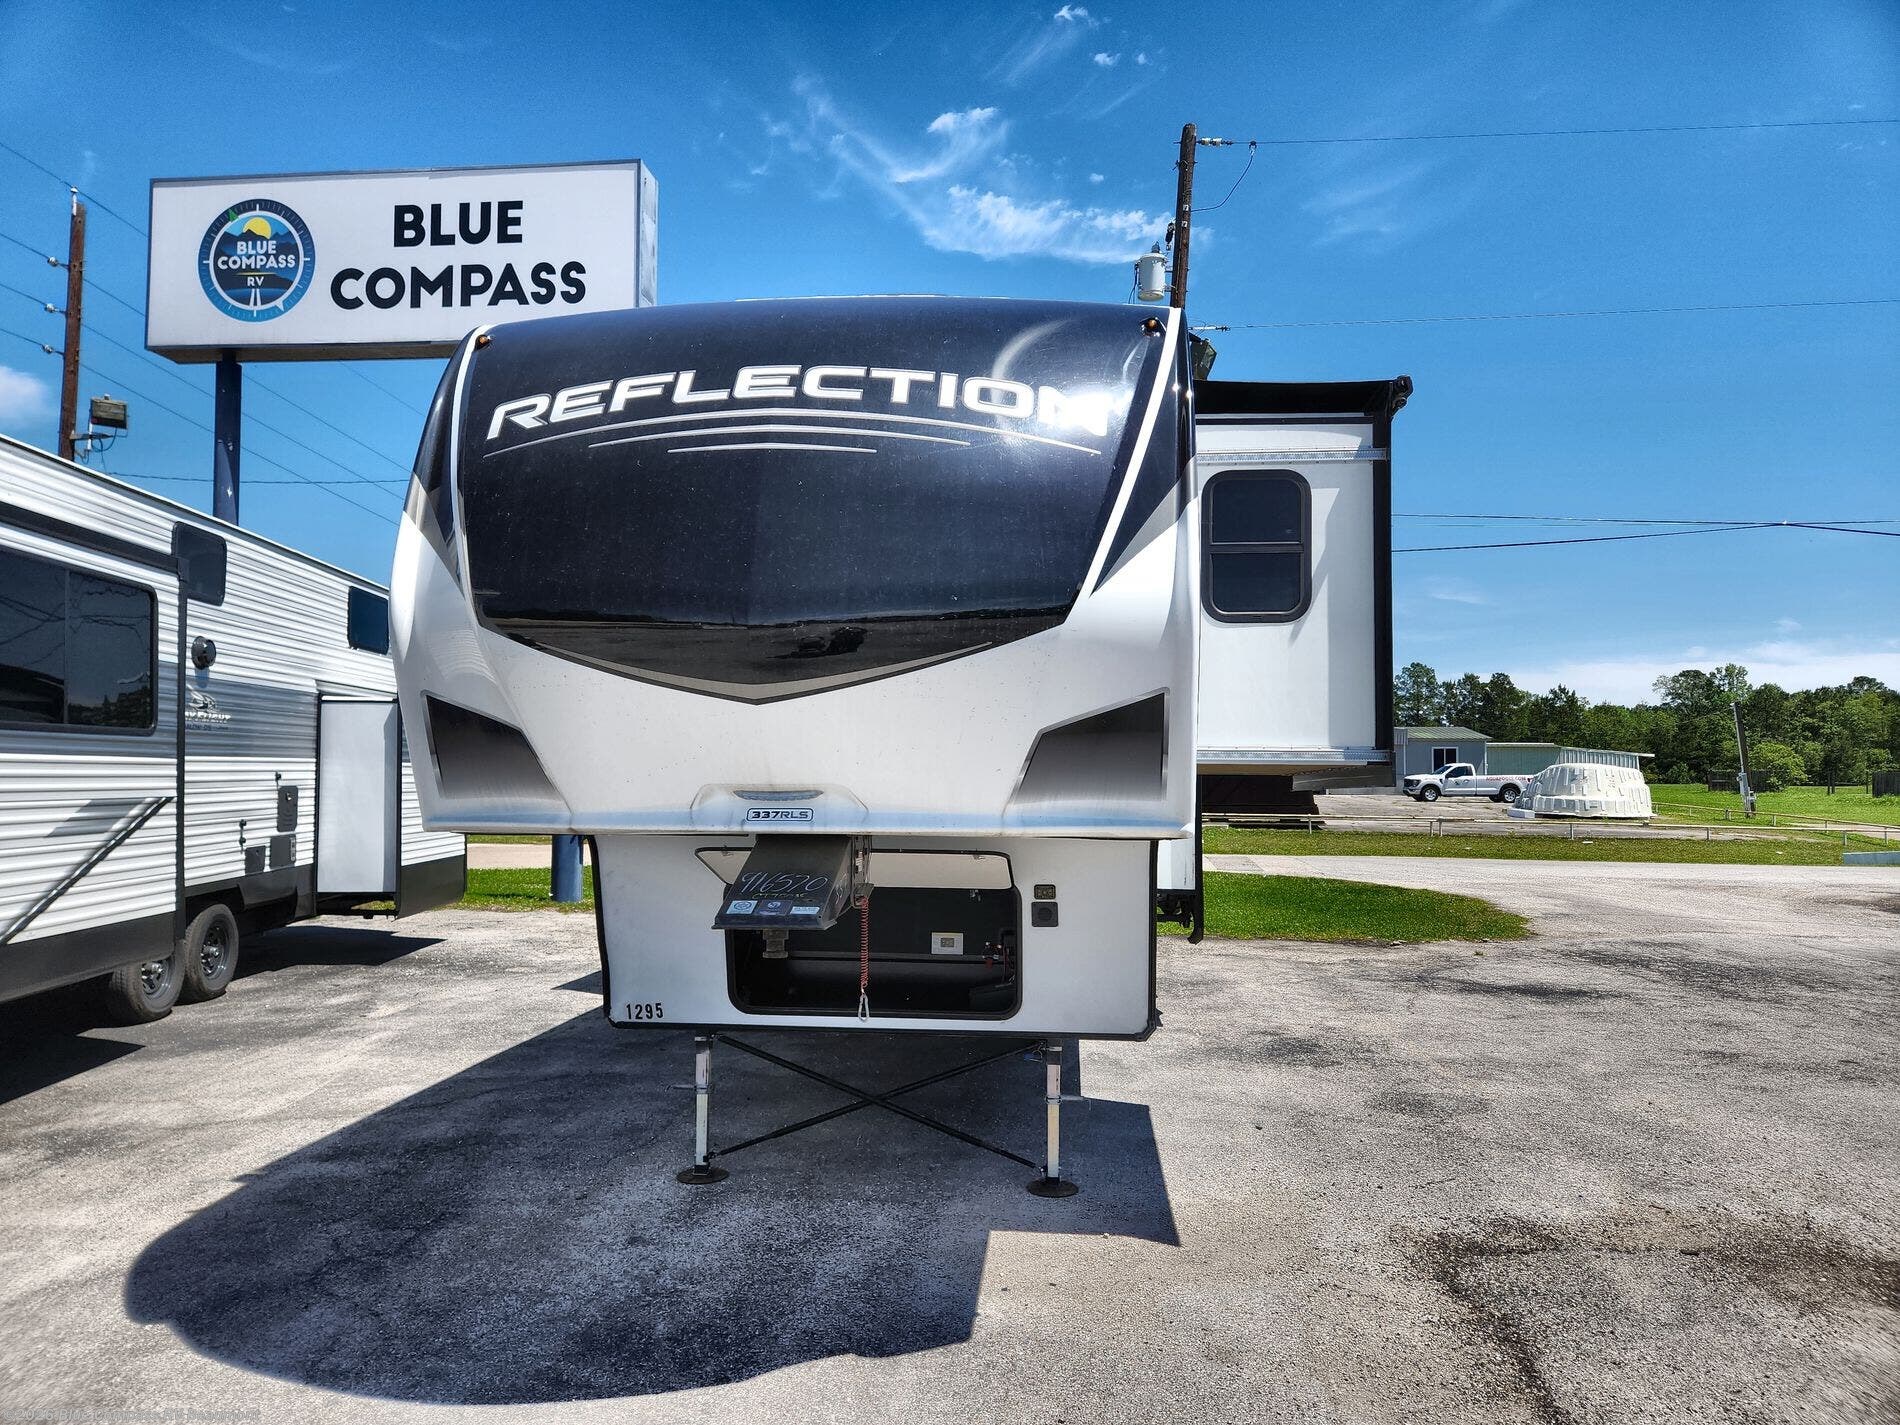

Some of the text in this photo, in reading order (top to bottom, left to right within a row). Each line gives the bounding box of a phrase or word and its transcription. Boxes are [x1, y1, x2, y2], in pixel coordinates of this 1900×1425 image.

[393, 200, 524, 248] BLUE
[236, 240, 277, 255] BLUE
[217, 254, 296, 270] COMPASS
[247, 276, 264, 287] RV
[330, 260, 586, 310] COMPASS
[486, 364, 1109, 439] REFLECTION
[751, 810, 809, 819] 337RLS
[626, 1003, 663, 1019] 1295
